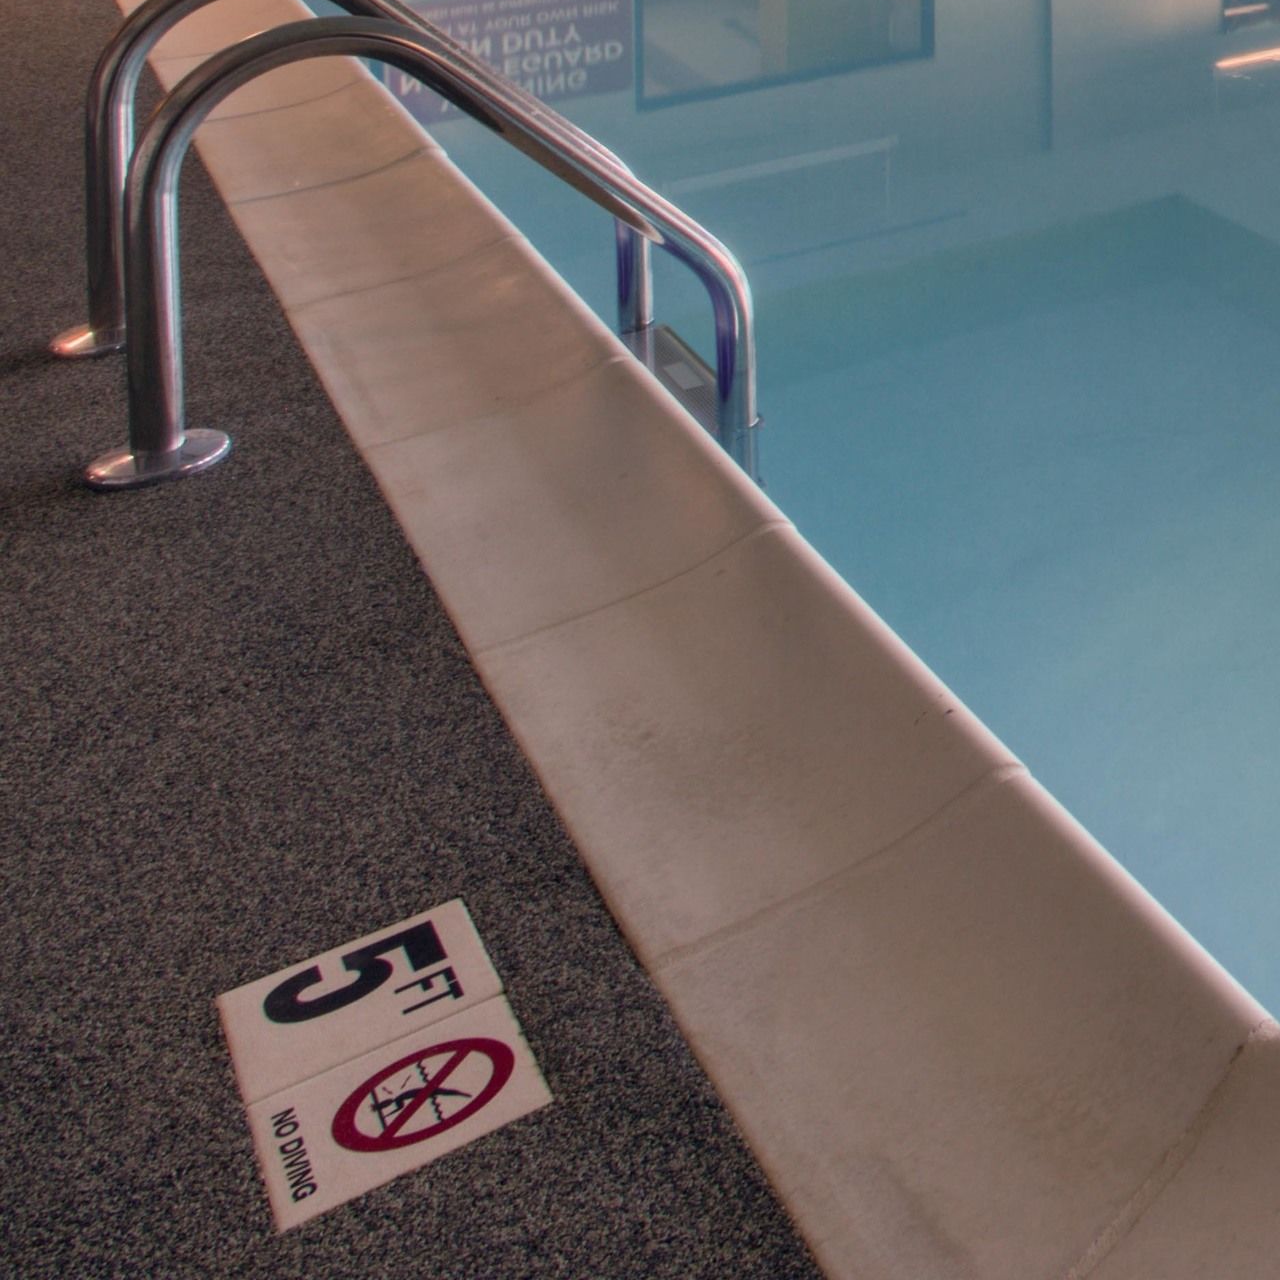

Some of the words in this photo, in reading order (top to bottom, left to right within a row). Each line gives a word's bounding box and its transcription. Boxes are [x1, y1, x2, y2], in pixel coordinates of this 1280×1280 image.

[262, 919, 448, 1024] 5
[393, 965, 465, 1015] FT
[270, 1106, 298, 1137] NO
[278, 1137, 318, 1203] DIVING
